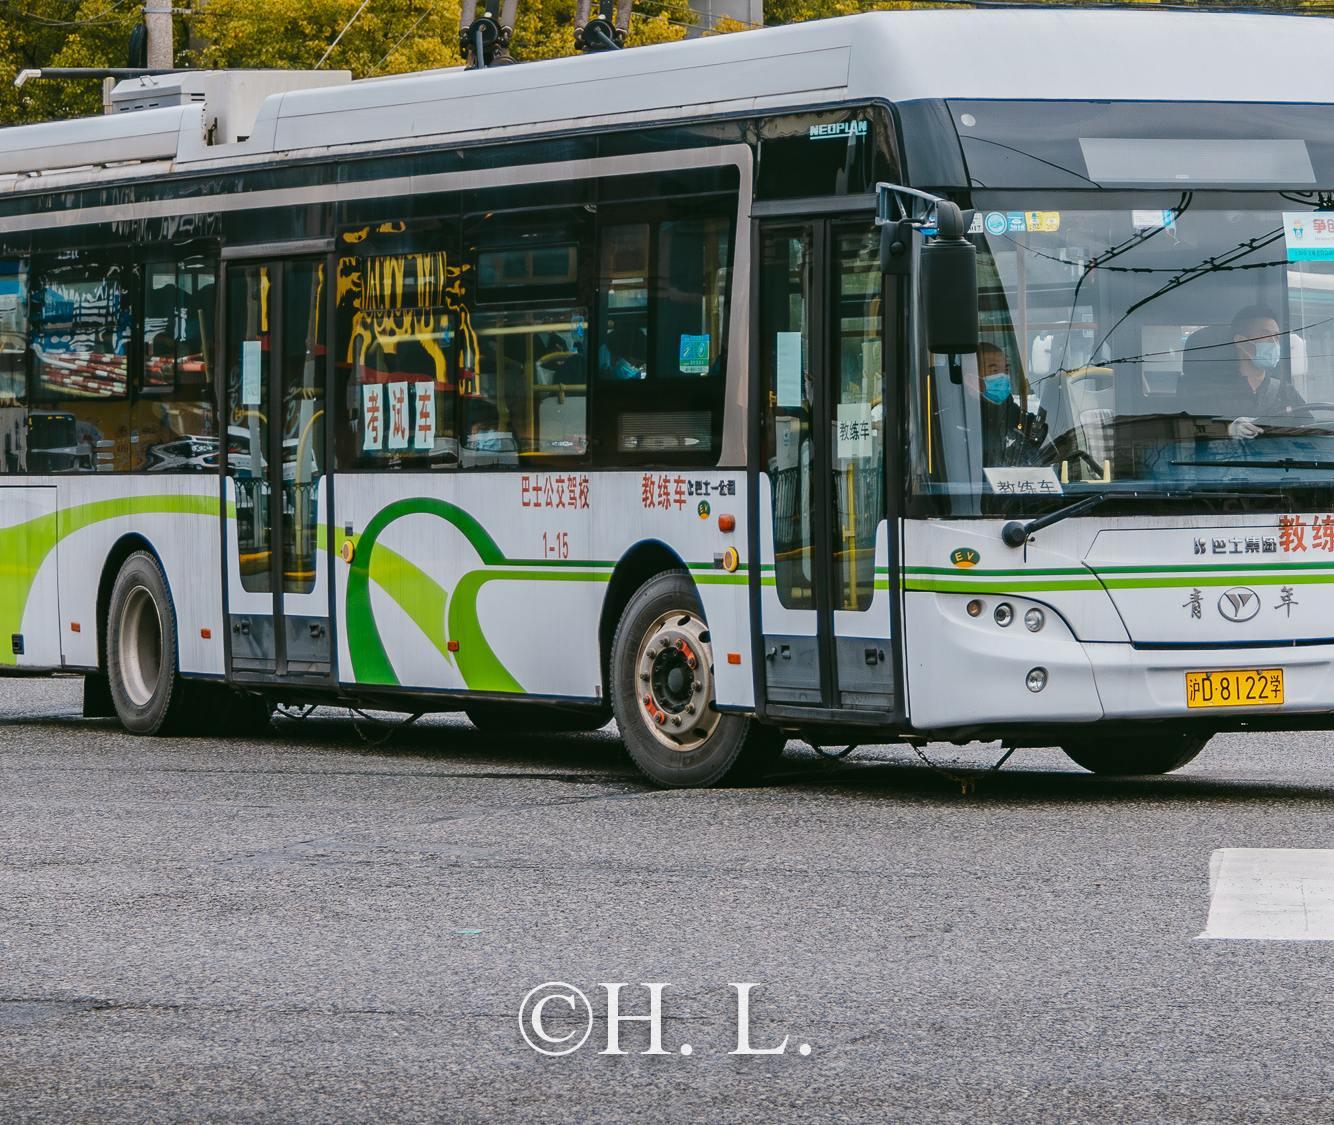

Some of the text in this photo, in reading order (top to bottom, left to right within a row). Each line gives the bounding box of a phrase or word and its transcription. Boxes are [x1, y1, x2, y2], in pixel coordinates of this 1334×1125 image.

[809, 119, 867, 137] NEOPLAN
[366, 386, 432, 444] 考试车
[839, 420, 870, 441] 教练车
[521, 474, 590, 510] 巴士公交驾校
[641, 473, 687, 511] 教练车
[996, 479, 1058, 494] 教练车
[543, 531, 569, 559] 1-15
[954, 551, 975, 562] EV
[1211, 535, 1277, 554] 巴士集团
[1182, 585, 1299, 619] 青 年
